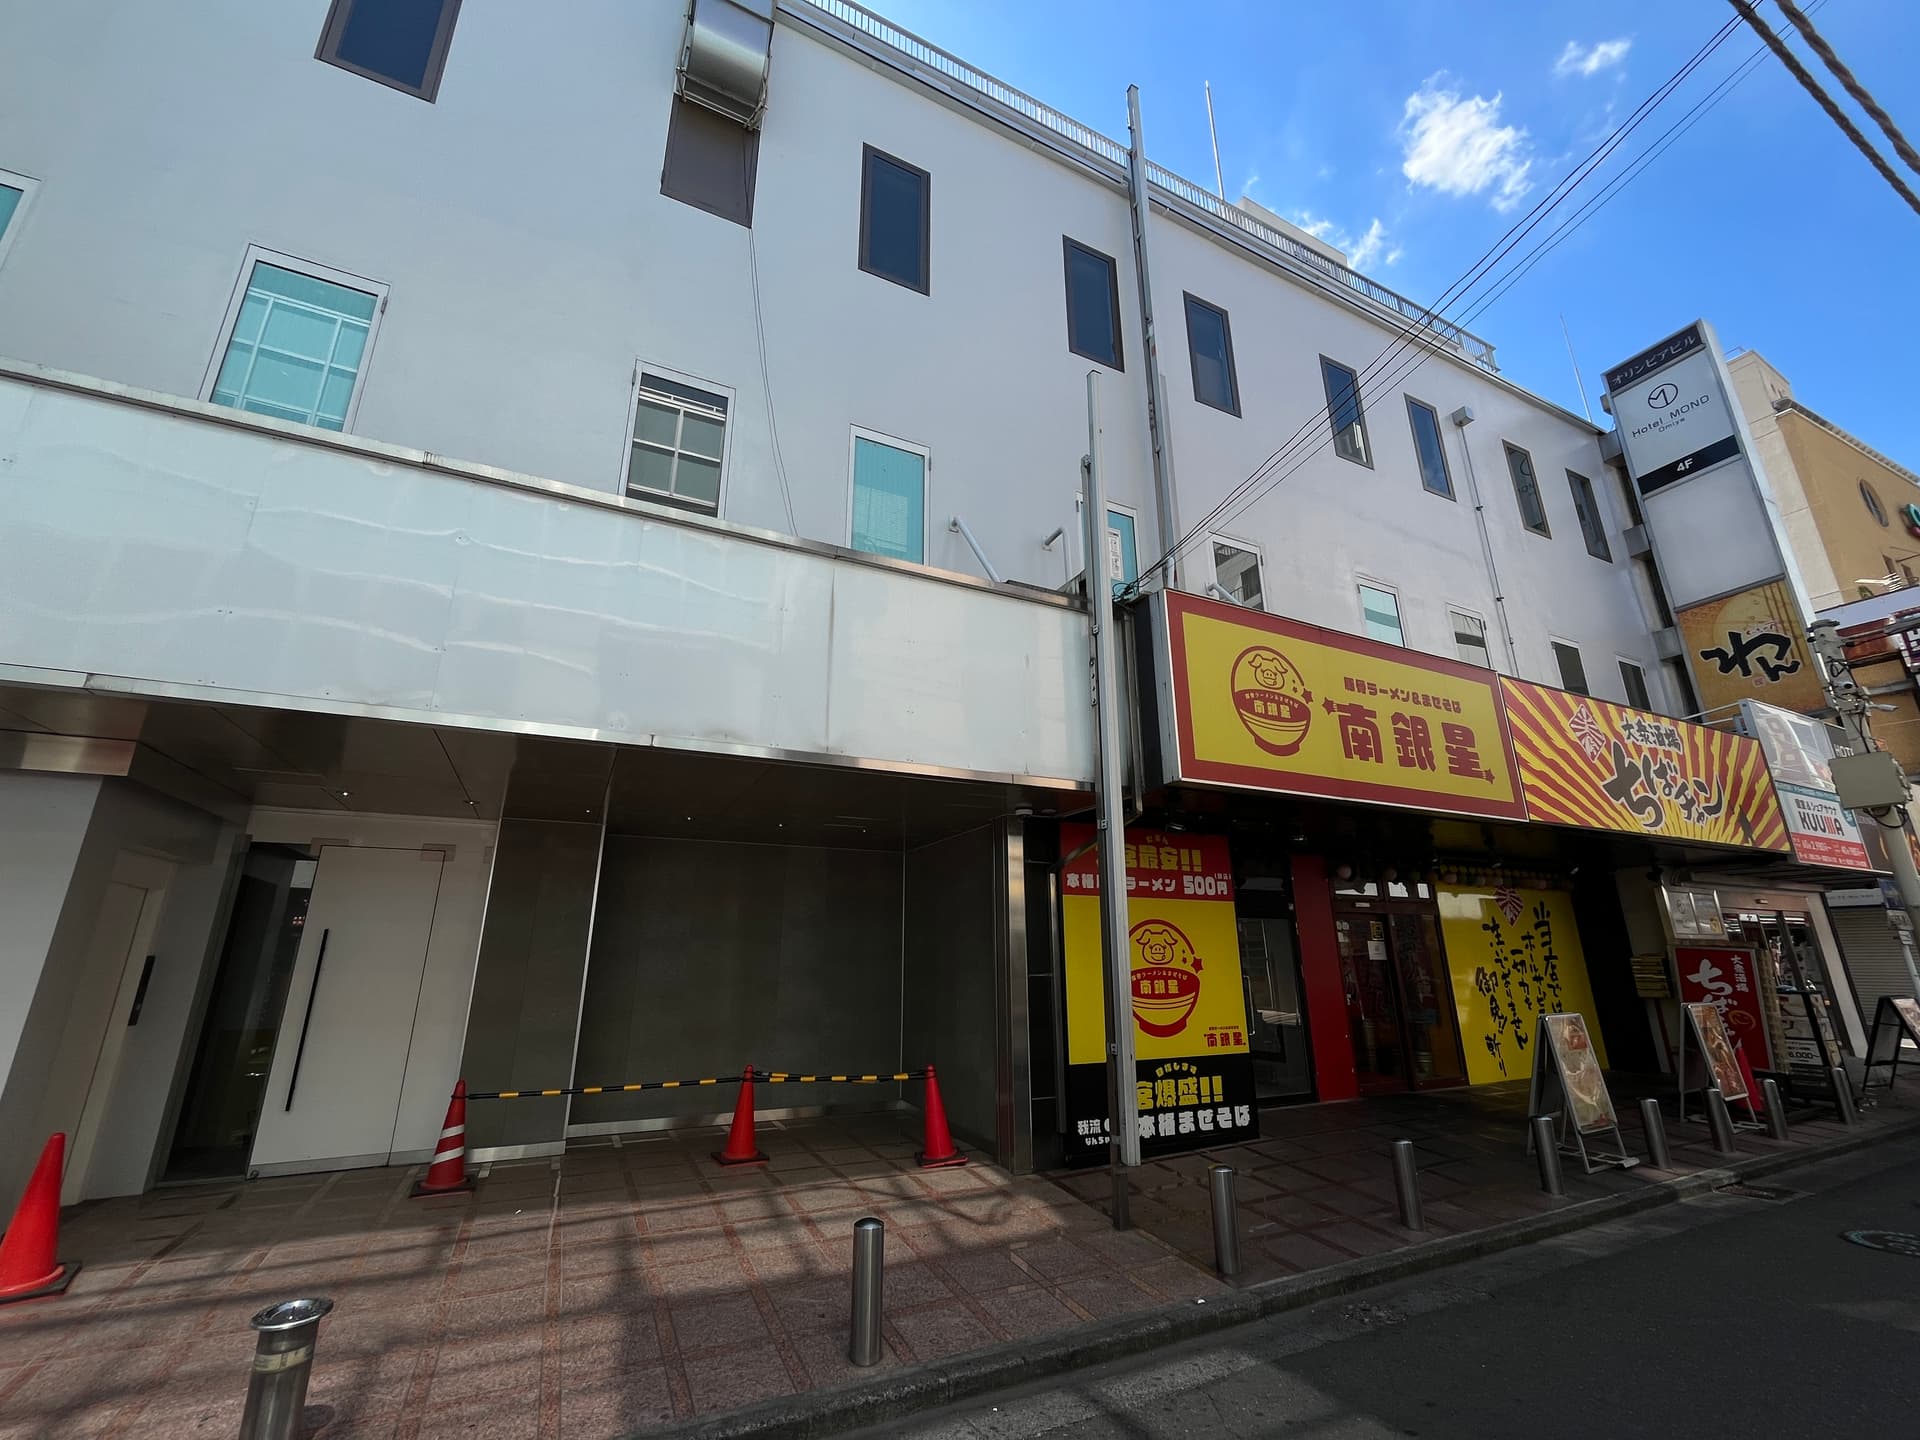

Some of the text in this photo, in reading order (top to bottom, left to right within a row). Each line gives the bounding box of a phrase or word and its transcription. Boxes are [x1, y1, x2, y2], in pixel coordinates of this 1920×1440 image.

[1612, 335, 1696, 385] オリンピアビル
[1631, 394, 1710, 438] Hotel MONO
[1658, 417, 1686, 432] Omiya
[1676, 458, 1694, 473] 4F
[1699, 631, 1801, 682] わん
[1333, 702, 1485, 779] 南銀星
[1621, 716, 1681, 753] 大衆酒場
[1602, 741, 1725, 828] ちばチャン
[1136, 1075, 1224, 1111] 宮爆盛!!
